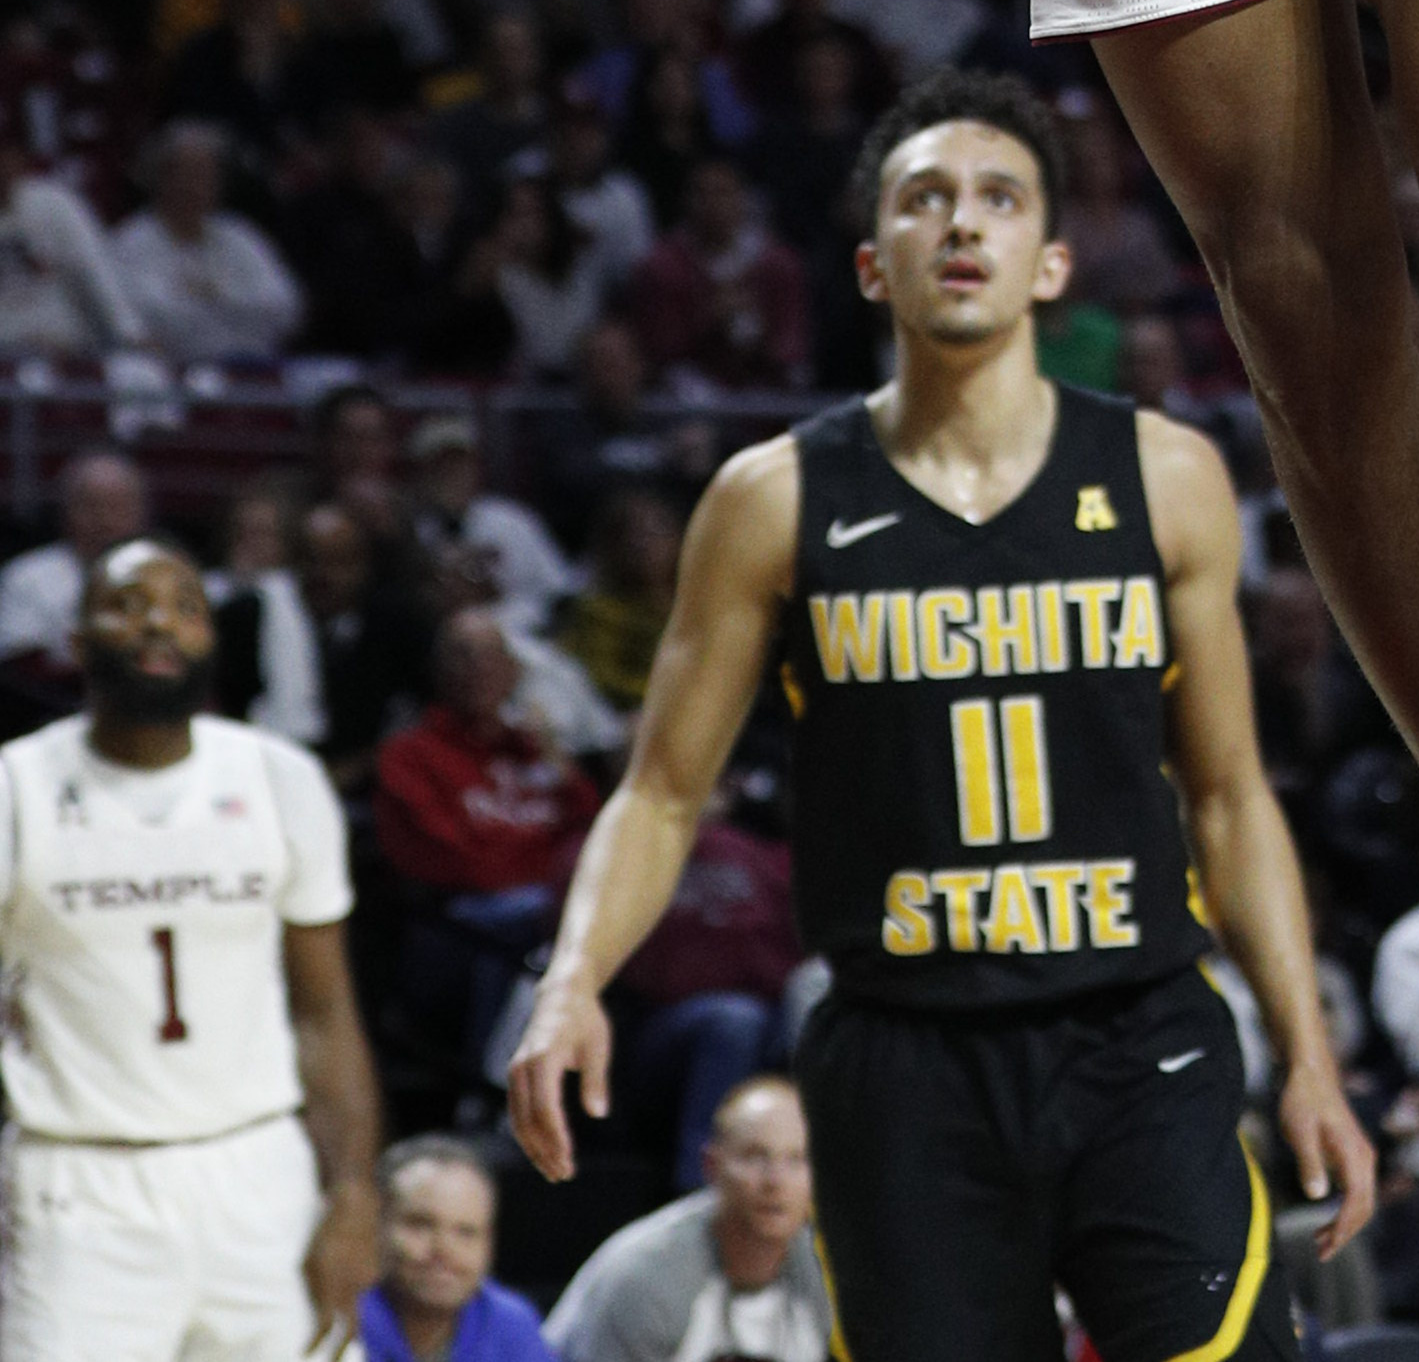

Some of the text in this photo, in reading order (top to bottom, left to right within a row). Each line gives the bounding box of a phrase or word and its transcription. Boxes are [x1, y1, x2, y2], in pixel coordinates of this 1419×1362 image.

[808, 575, 1165, 684] WICHITA
[950, 694, 1052, 847] 11
[52, 872, 264, 914] TEMPLE
[881, 858, 1141, 956] STATE
[149, 927, 189, 1044] 1
